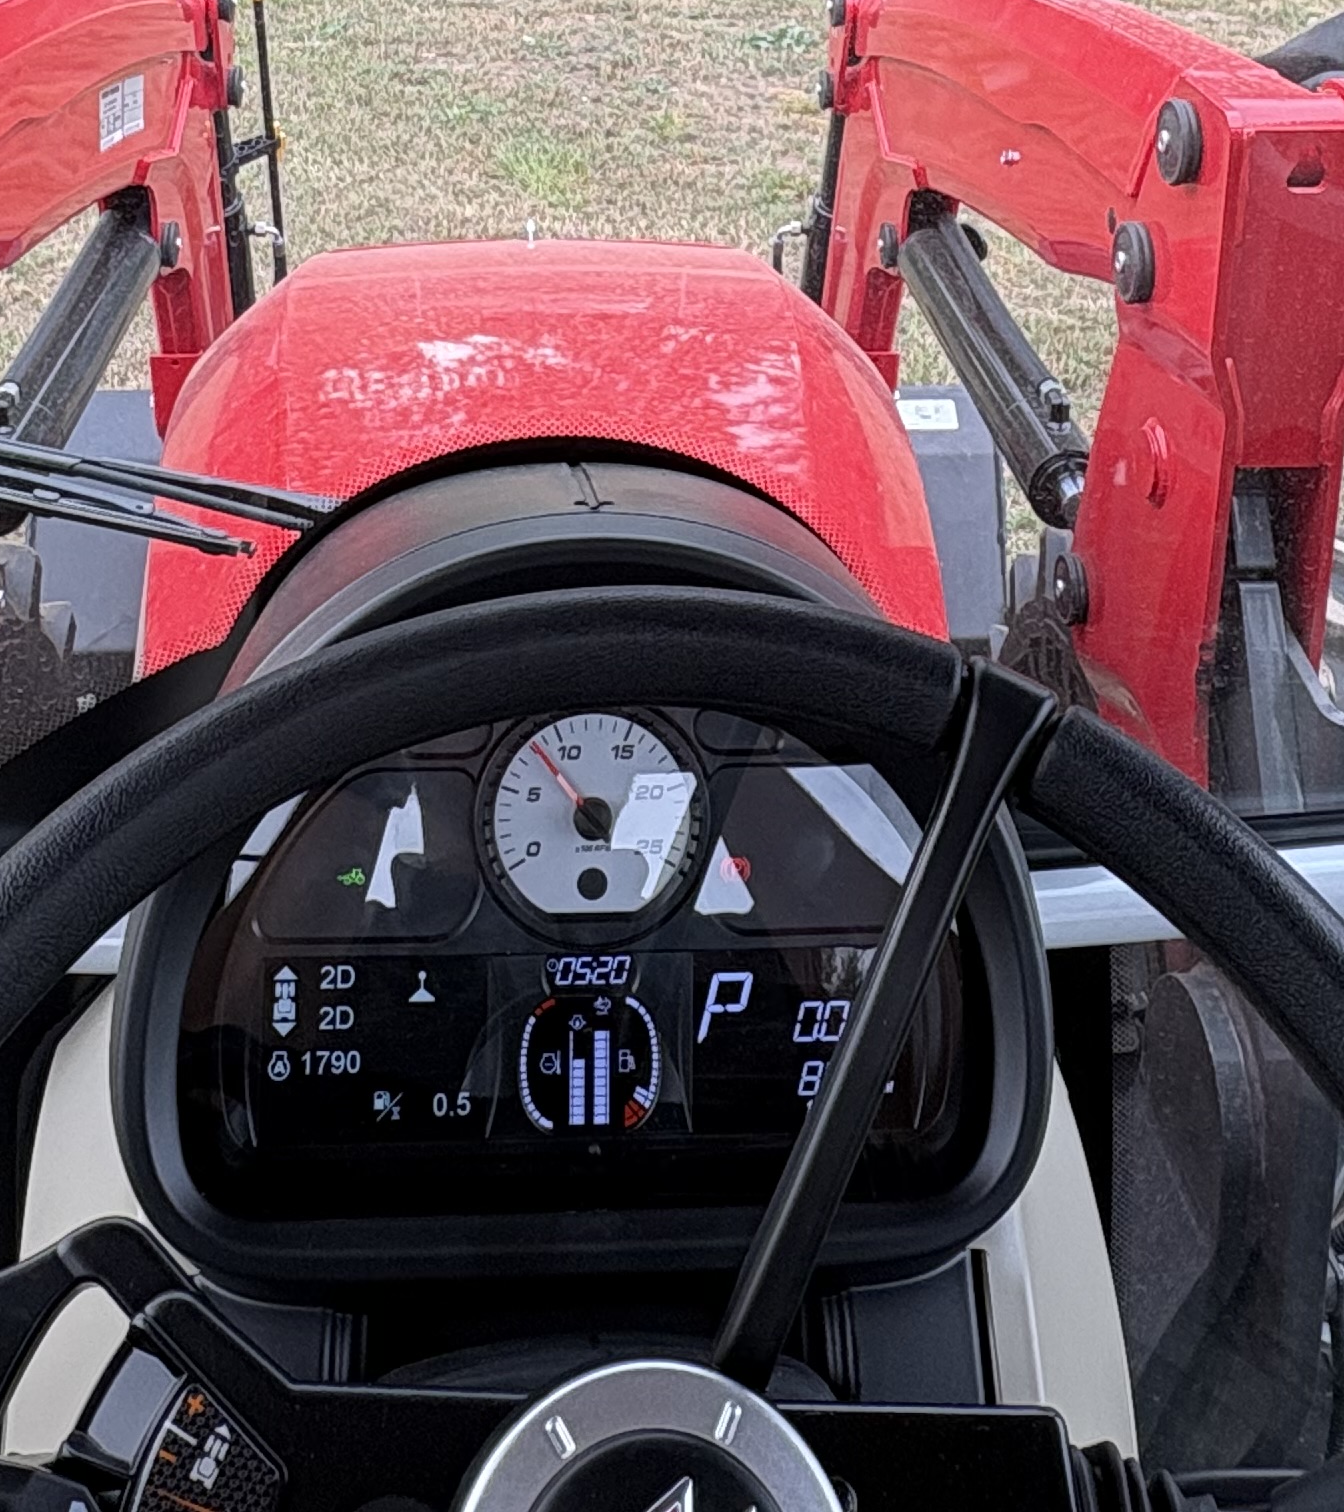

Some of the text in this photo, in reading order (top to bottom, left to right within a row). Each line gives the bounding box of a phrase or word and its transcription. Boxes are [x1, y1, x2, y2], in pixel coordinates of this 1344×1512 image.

[557, 745, 582, 761] 10
[611, 745, 635, 760] 15
[526, 787, 542, 803] 5
[635, 785, 664, 800] 20
[526, 841, 541, 857] 0
[634, 839, 664, 855] 25
[320, 965, 356, 989] 2D
[555, 955, 632, 985] 05:20
[318, 1006, 355, 1030] 2D
[697, 972, 754, 1044] P
[301, 1050, 361, 1075] 1790
[797, 1060, 831, 1096] 8
[432, 1092, 472, 1117] 0.5
